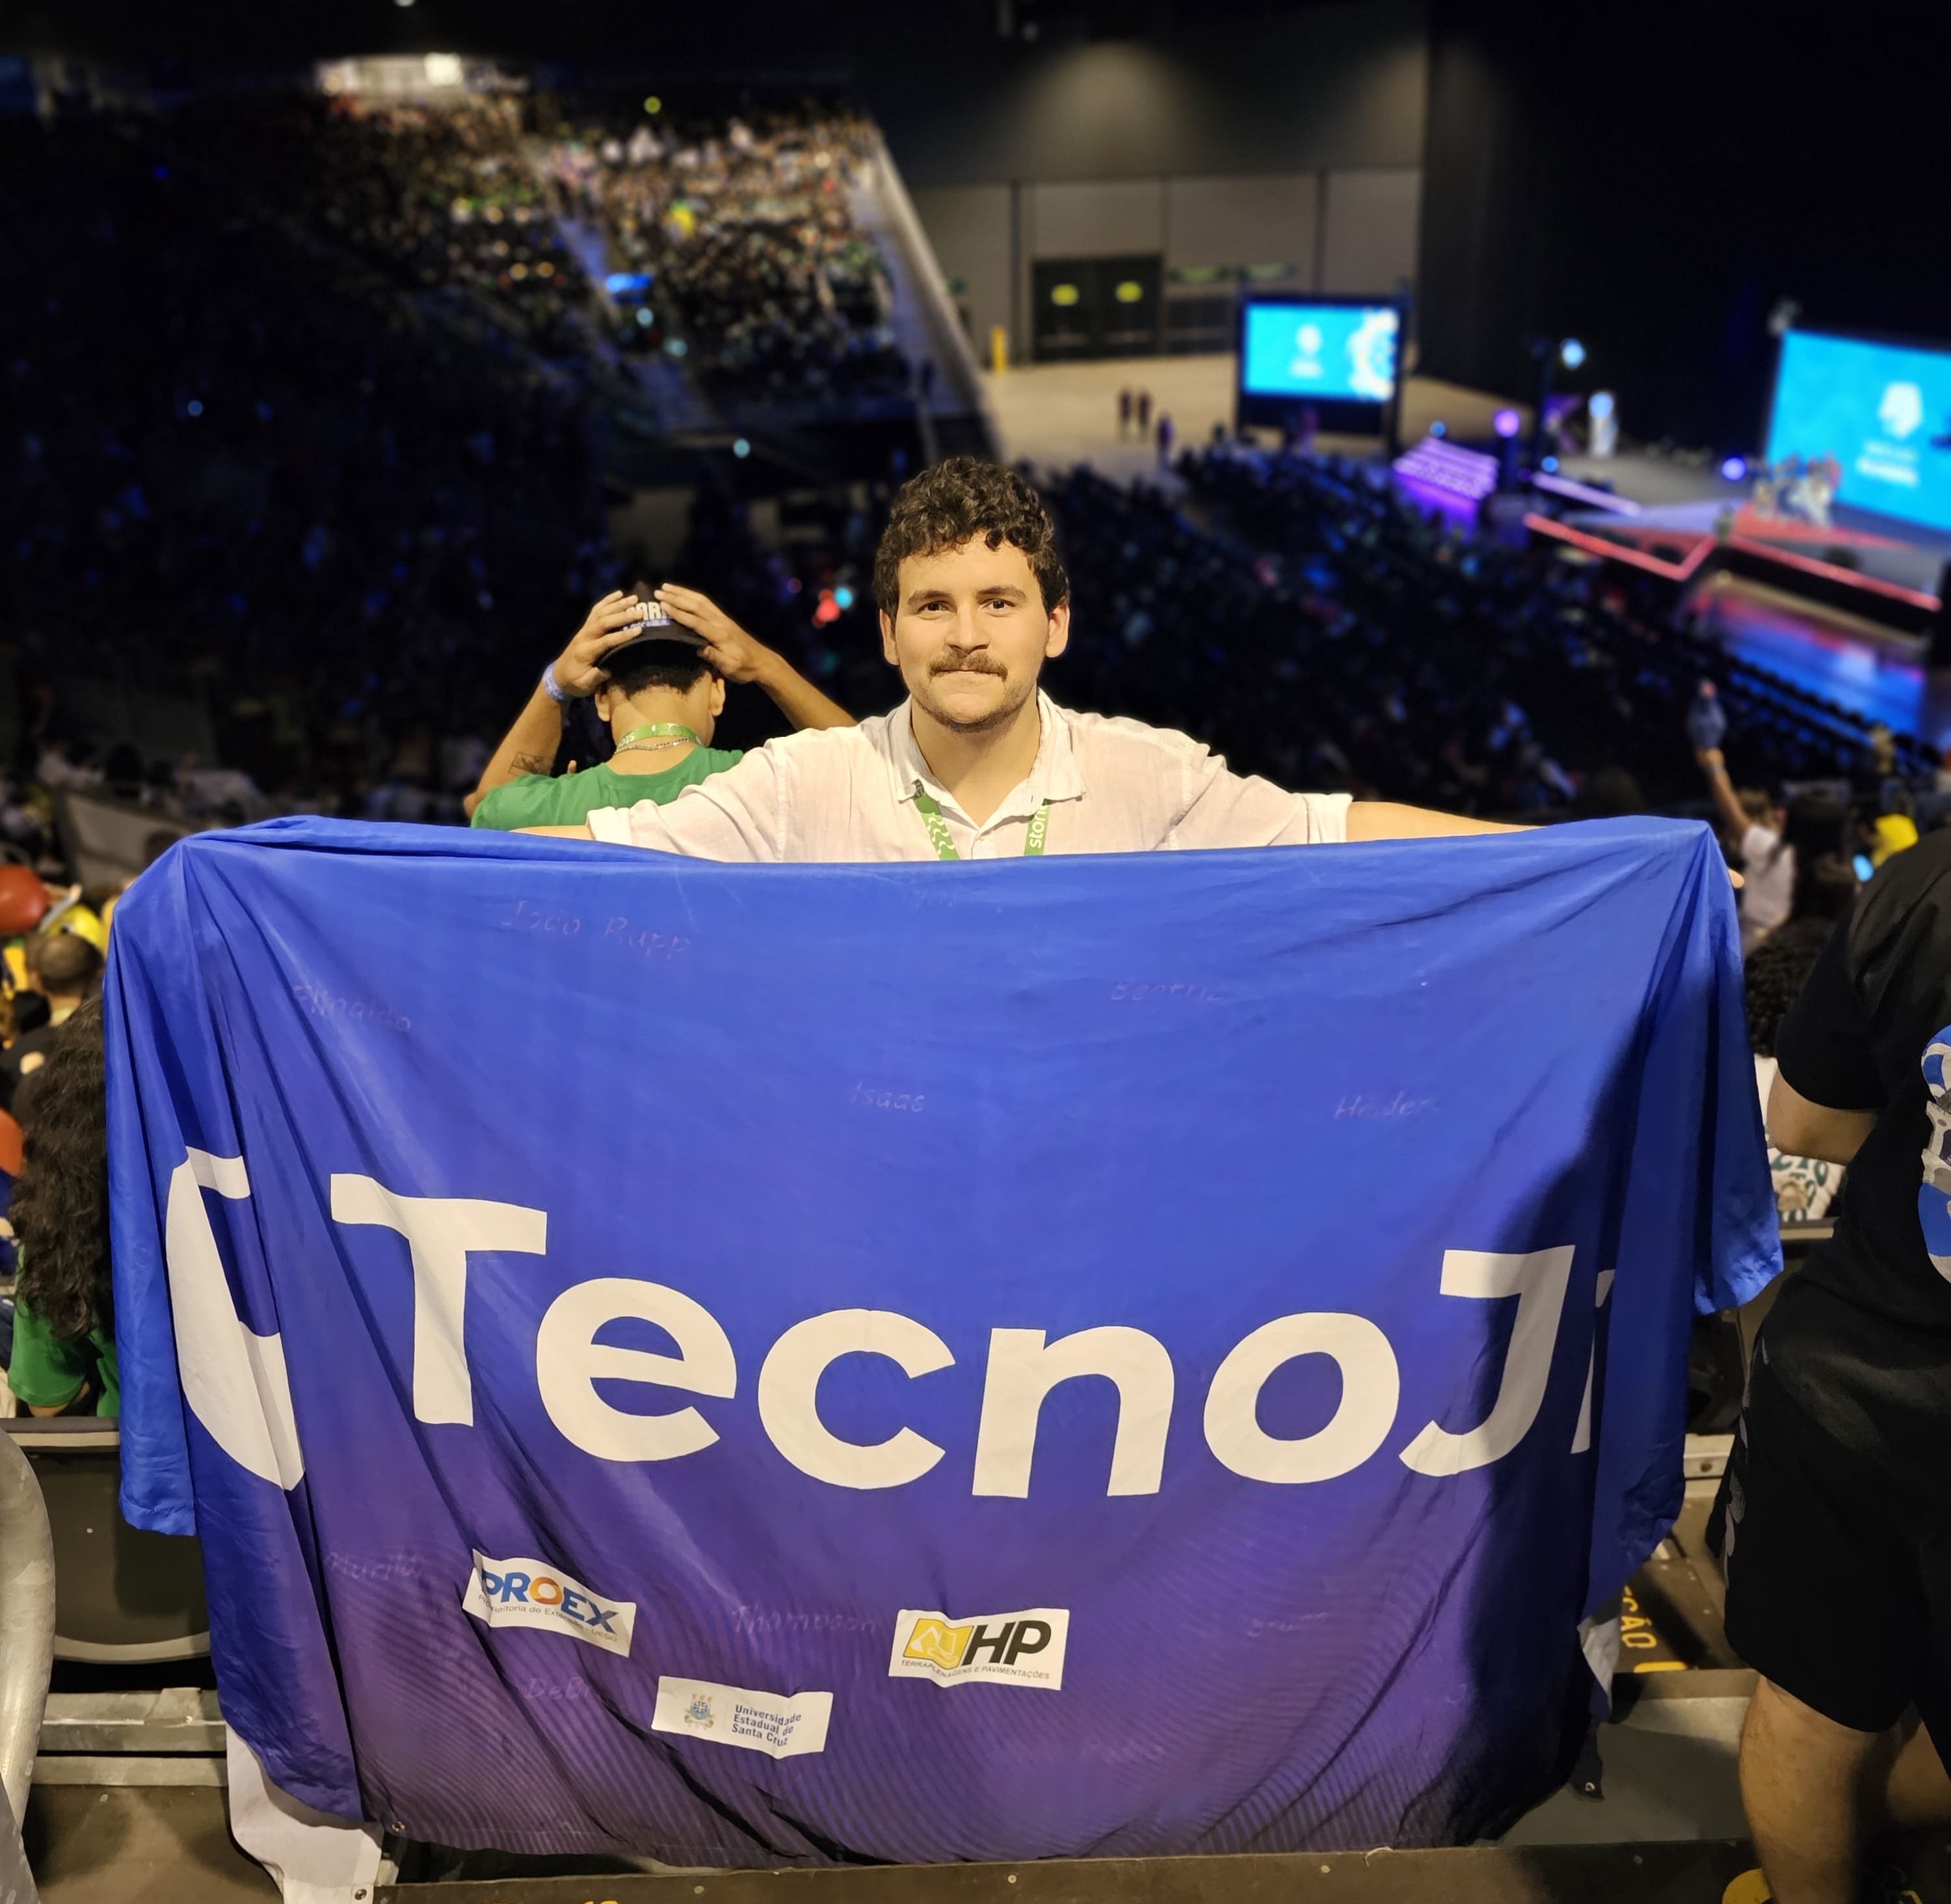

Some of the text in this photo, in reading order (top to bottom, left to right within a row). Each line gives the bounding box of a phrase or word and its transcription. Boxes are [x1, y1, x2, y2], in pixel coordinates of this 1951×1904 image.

[482, 1570, 618, 1635] PROEX
[961, 1620, 1052, 1667] HP
[901, 1659, 972, 1678] TERRAPLENAGENS
[981, 1665, 1050, 1680] PAVIMENTAÇÕES
[734, 1713, 793, 1736] Estadual de
[735, 1704, 801, 1726] Universidade
[732, 1723, 788, 1747] Santa Cruz
